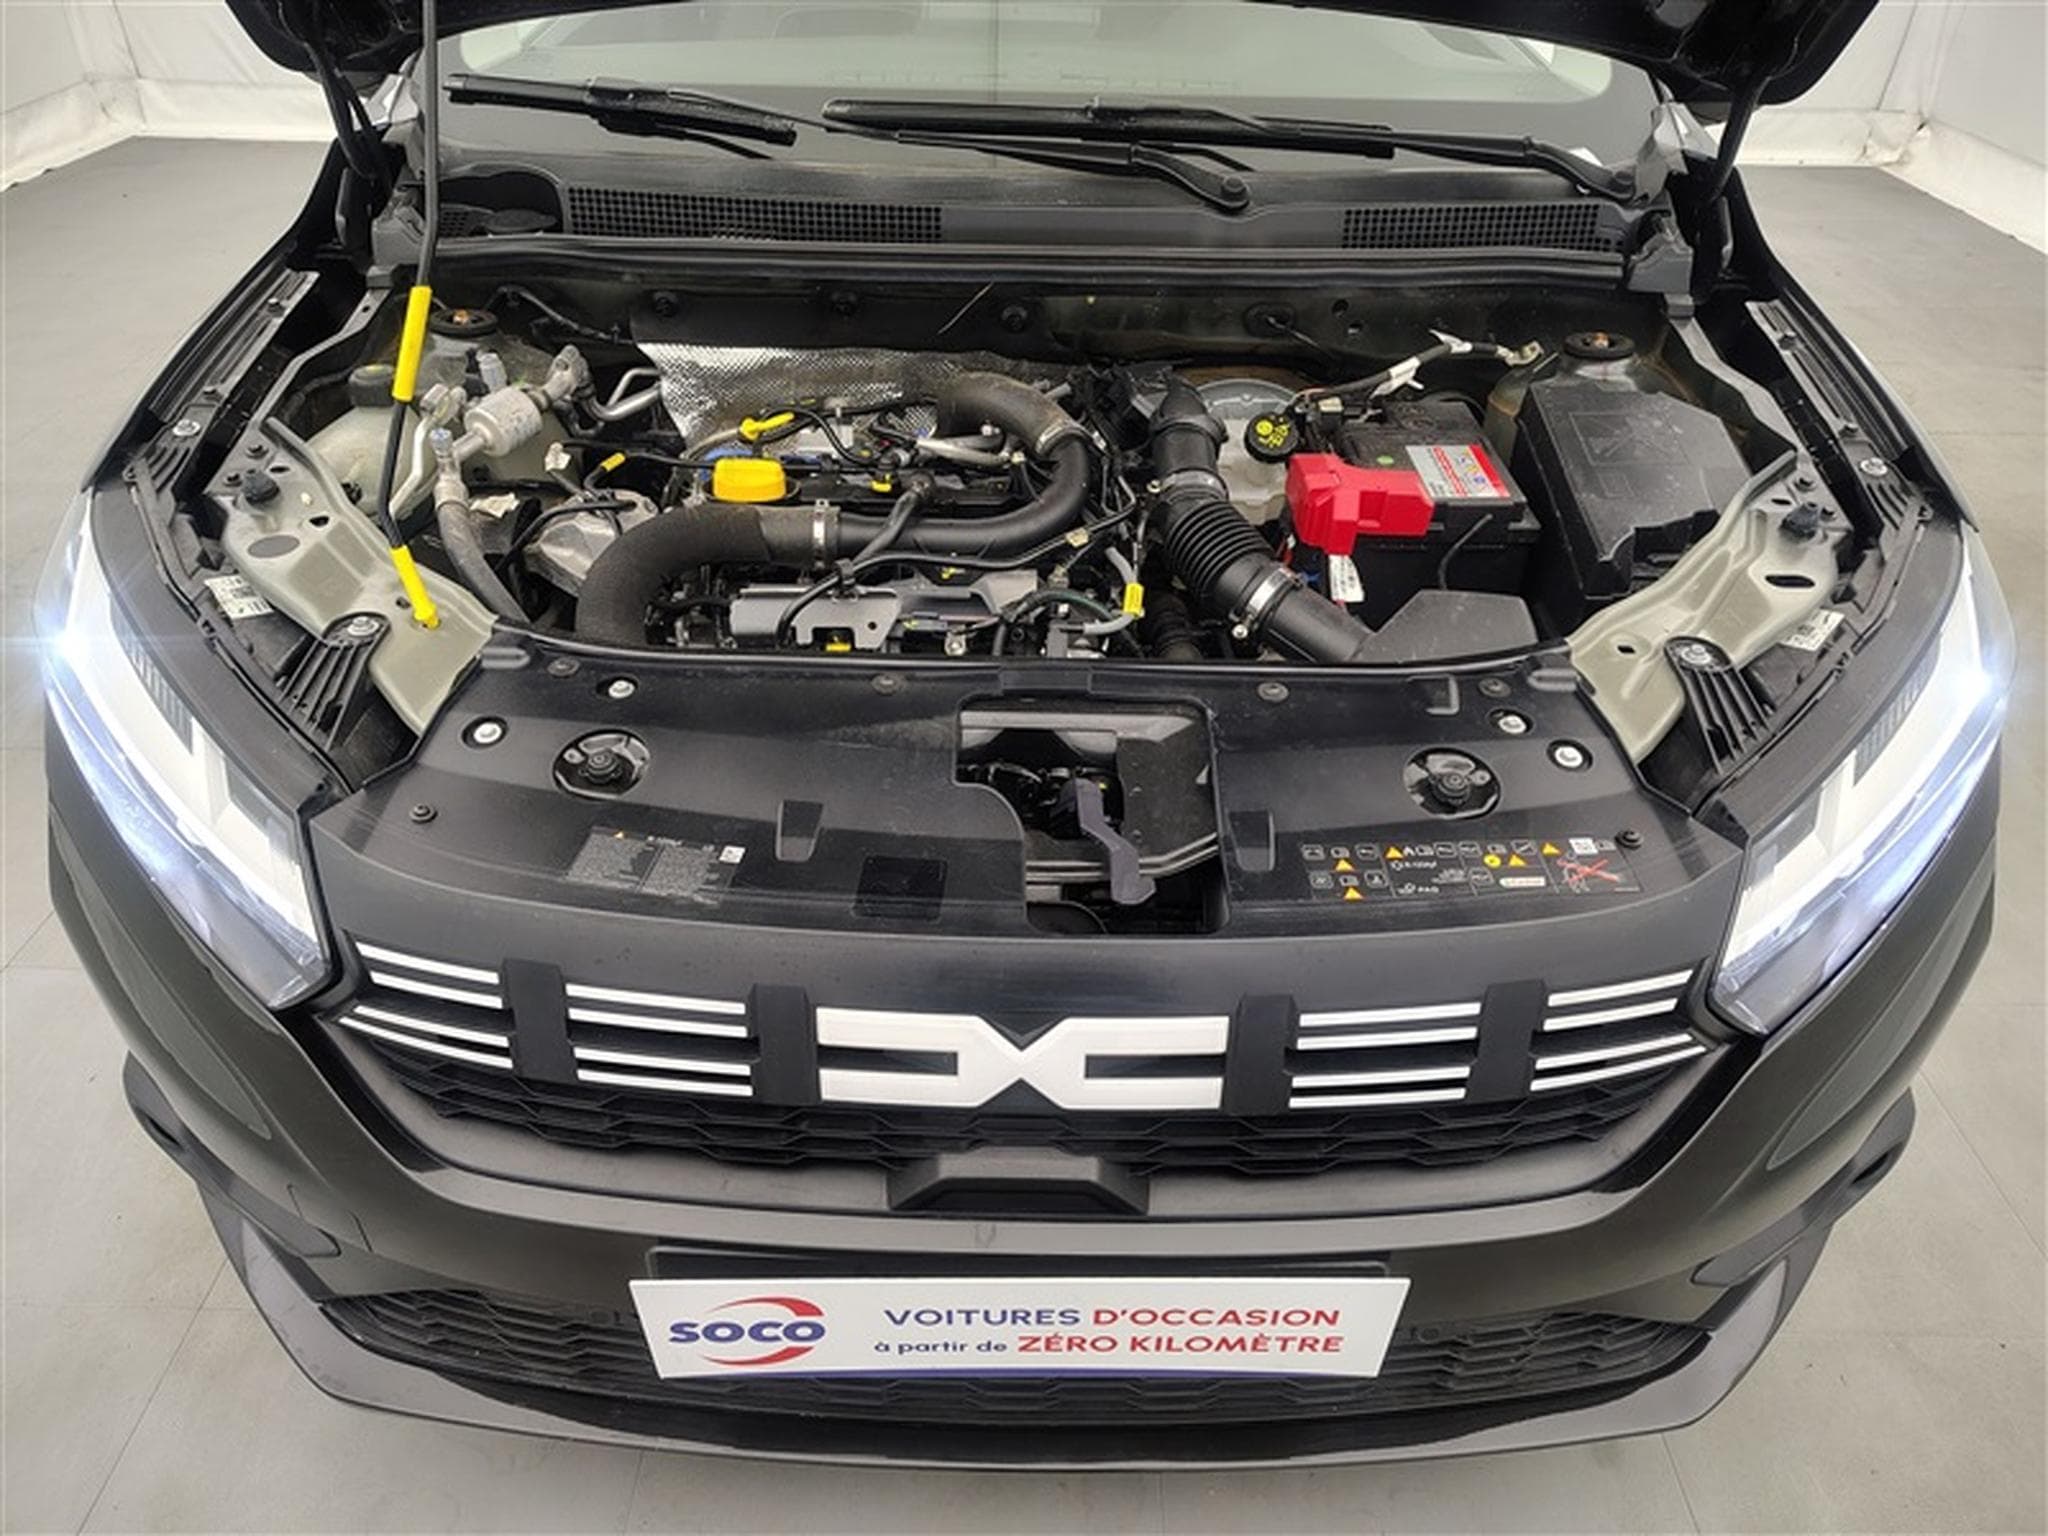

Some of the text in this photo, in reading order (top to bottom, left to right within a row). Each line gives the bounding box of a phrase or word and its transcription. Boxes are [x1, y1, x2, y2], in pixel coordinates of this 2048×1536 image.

[884, 1307, 1341, 1327] VOITURES D'OCCASION
[668, 1320, 826, 1343] SOCO
[873, 1330, 1345, 1355] à partir de ZÉRO KILOMÈTRE
